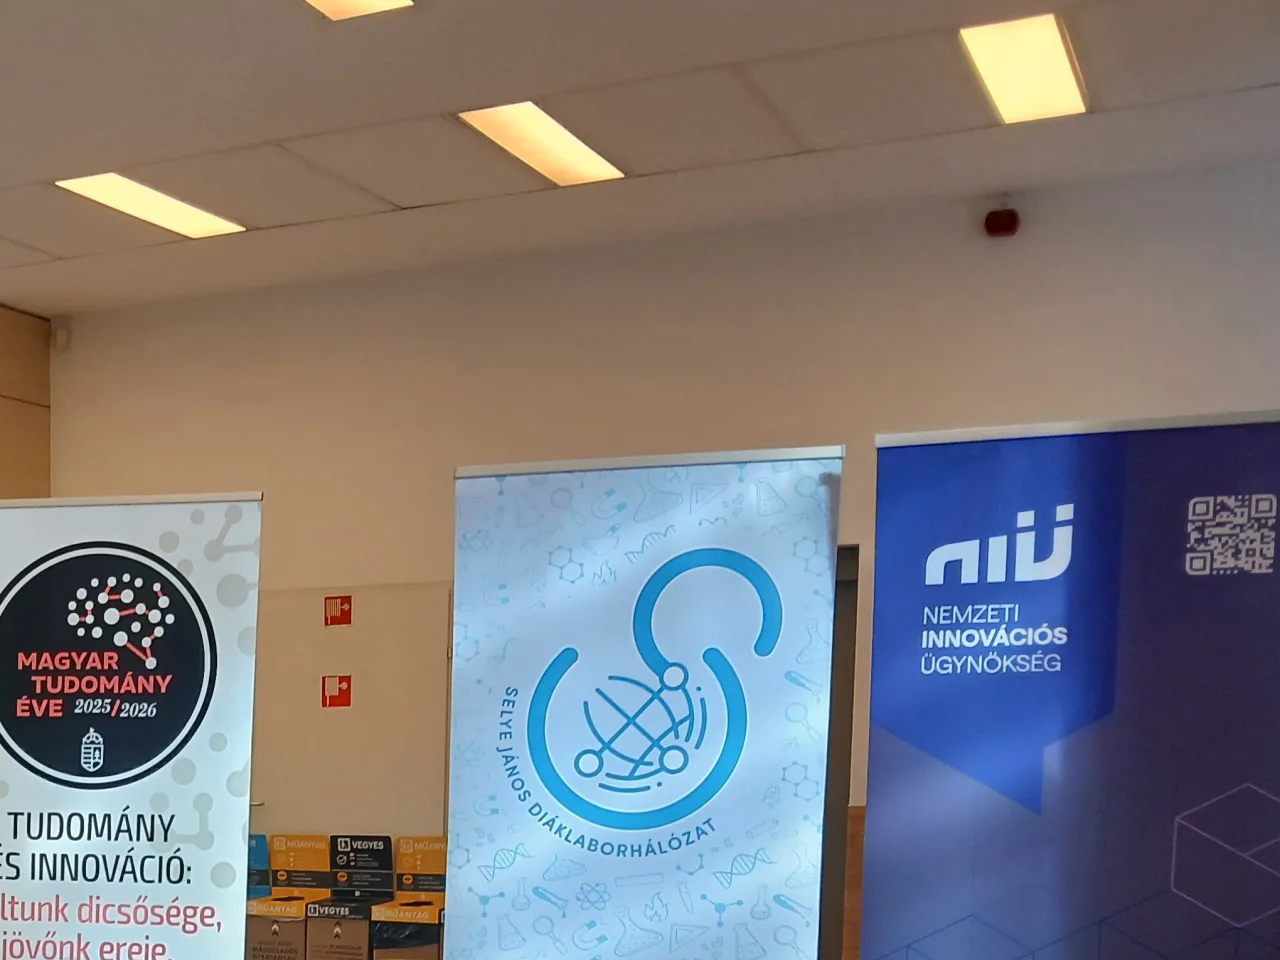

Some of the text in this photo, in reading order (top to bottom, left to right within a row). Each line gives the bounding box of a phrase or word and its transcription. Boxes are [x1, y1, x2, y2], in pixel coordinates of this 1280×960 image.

[922, 603, 1019, 625] NEMZETI
[921, 623, 1068, 649] INNOVÁCIÓS
[17, 651, 119, 671] MAGYAR
[920, 651, 1062, 676] ÜGYNÖKSÉG
[31, 671, 173, 694] TUDOMÁNY
[16, 695, 158, 719] ÉVE 2025/2026
[496, 686, 719, 858] SELYE JÁNOS DIÁKLABORHÁLÓZAT
[7, 805, 176, 843] TUDOMÁNY
[351, 840, 385, 850] VEGYES
[30, 847, 192, 885] INNOVÁCIÓ:
[77, 894, 222, 934] dicsősége,
[319, 905, 350, 916] VEGYES
